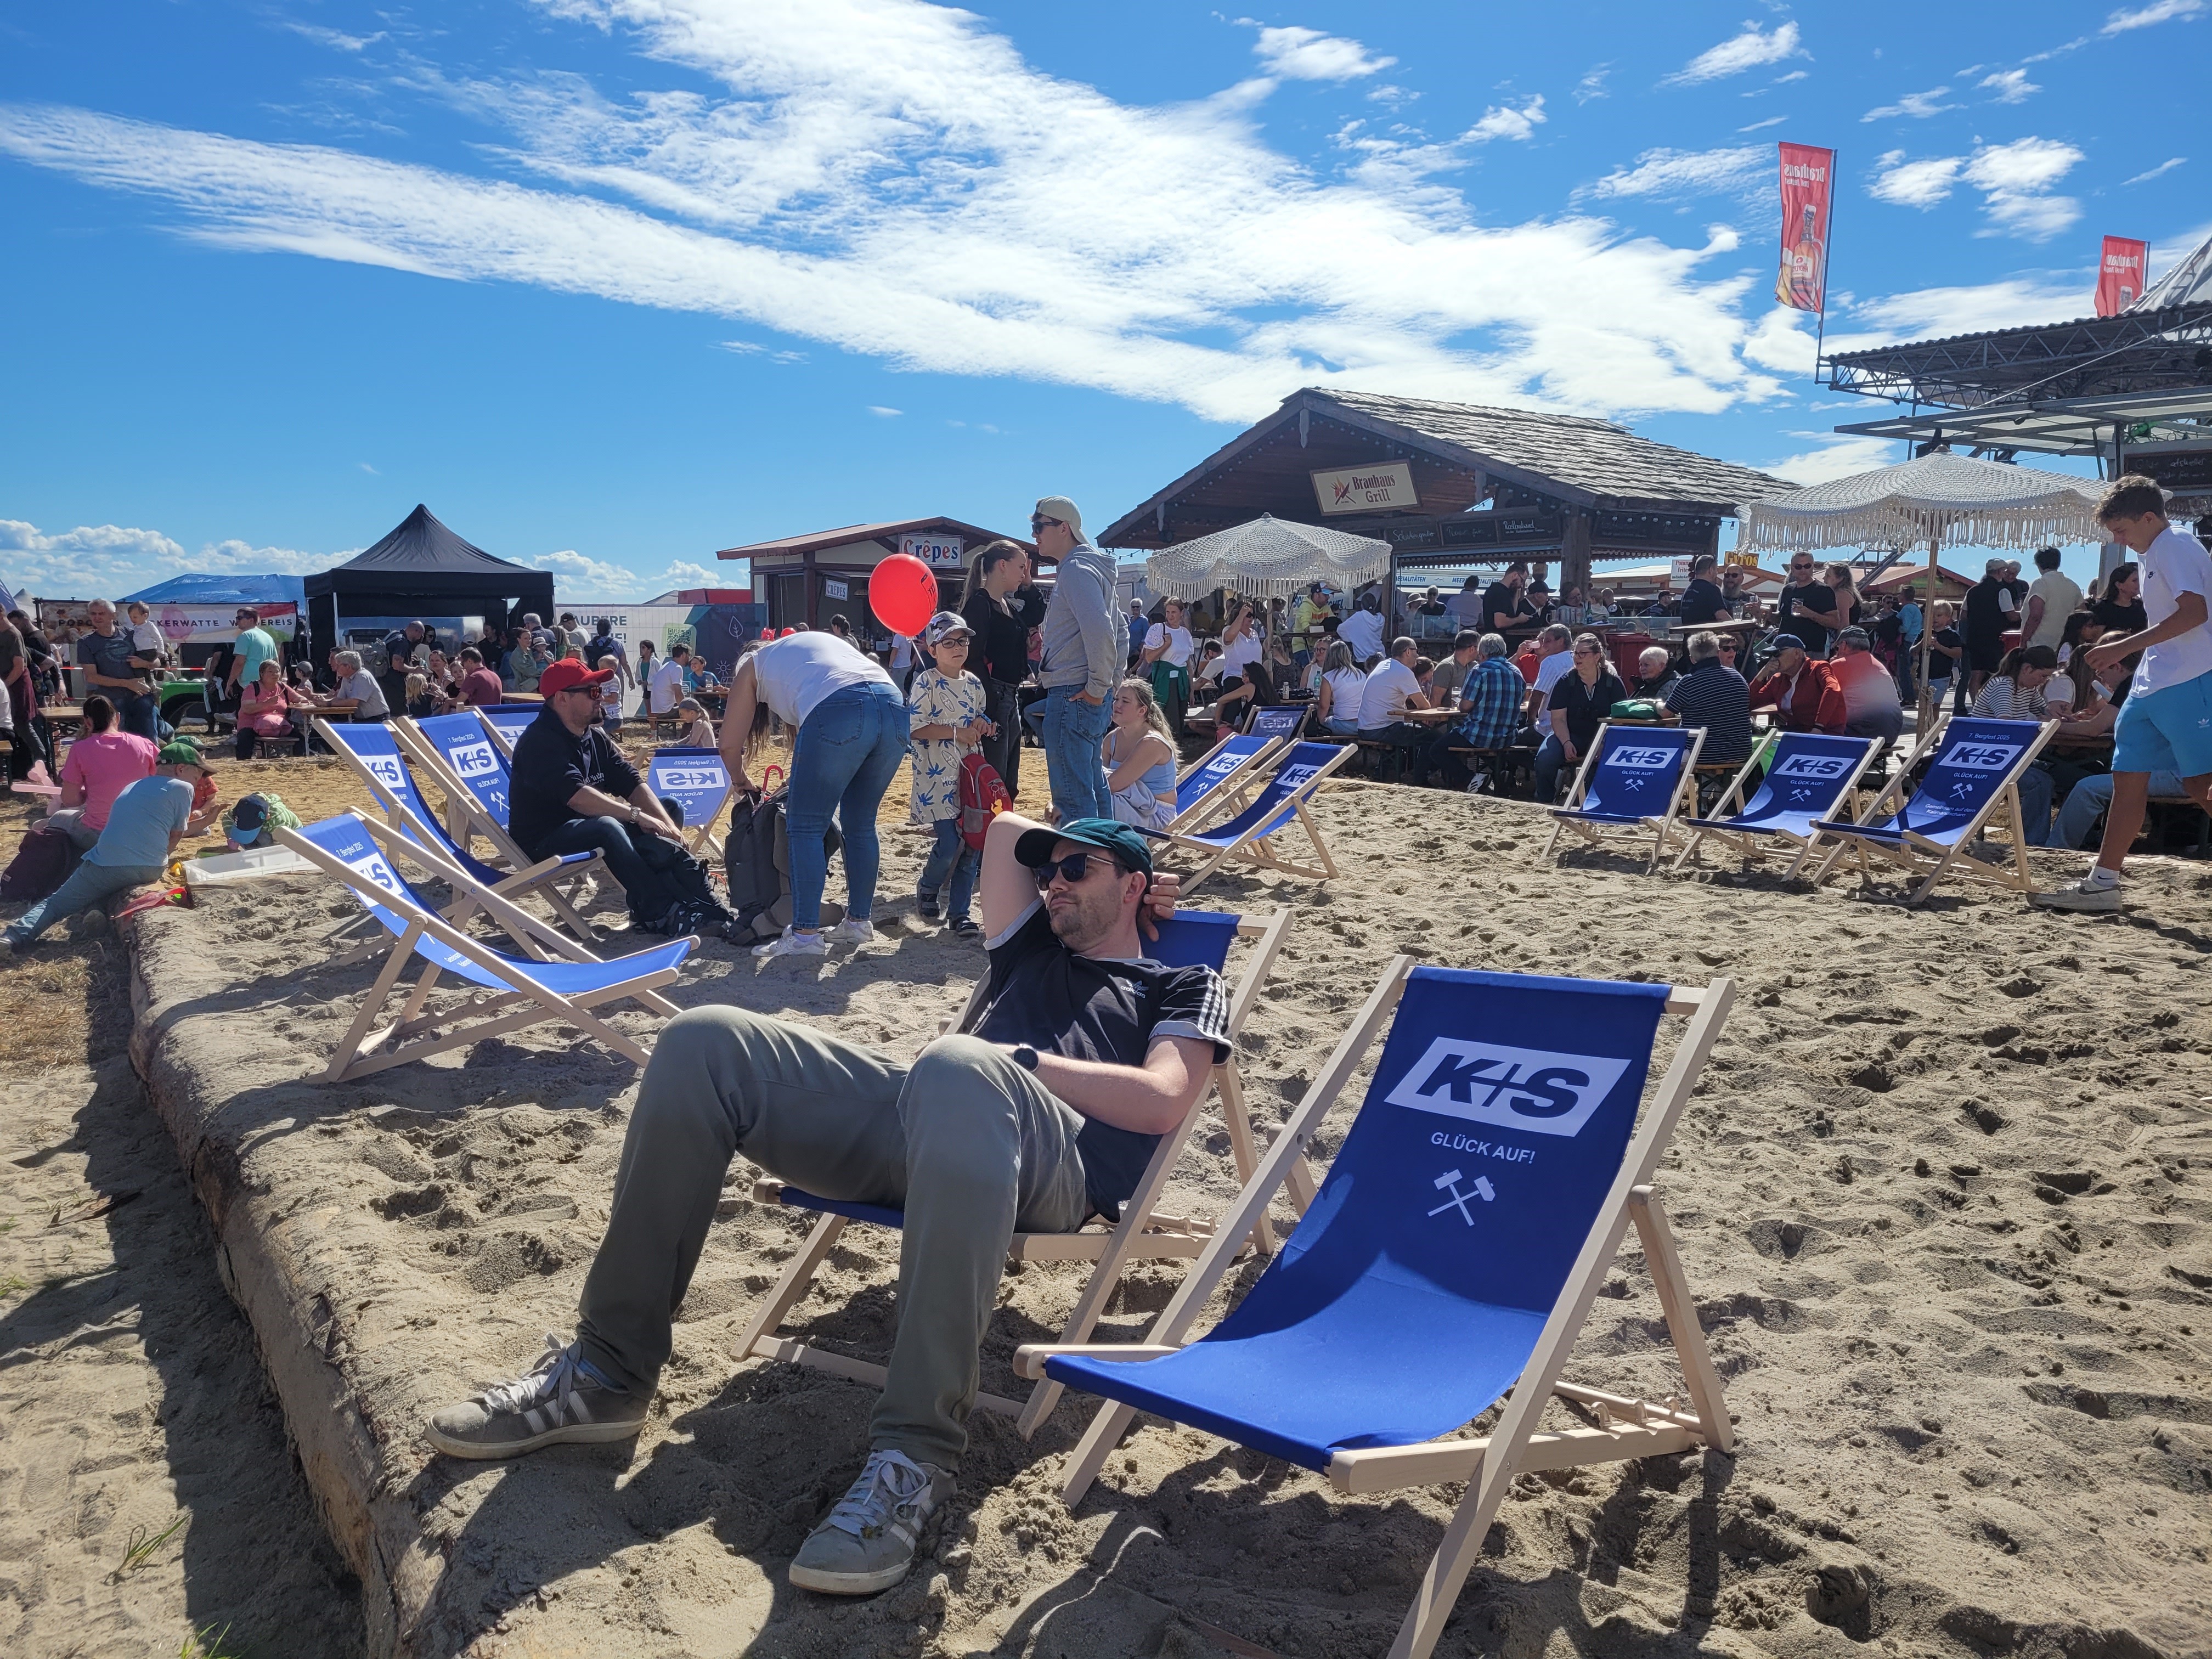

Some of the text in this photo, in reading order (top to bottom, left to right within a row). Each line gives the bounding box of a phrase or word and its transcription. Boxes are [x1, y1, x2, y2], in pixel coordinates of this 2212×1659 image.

[1352, 475, 1396, 490] Brauhaus
[1365, 488, 1391, 503] Grill
[904, 539, 959, 563] Crêpes
[827, 583, 846, 597] CRÊPES
[455, 748, 492, 772] K+S
[1211, 757, 1242, 769] K+S
[1615, 750, 1668, 765] K+S
[1949, 747, 2010, 765] K+S
[1785, 759, 1843, 775] K+S
[477, 780, 492, 788] GLÜCK
[1283, 768, 1318, 784] K+S
[359, 862, 393, 890] +S
[1120, 986, 1146, 998] adidas
[1415, 1053, 1590, 1119] K+S
[1430, 1131, 1536, 1165] GLÜCK AUF!
